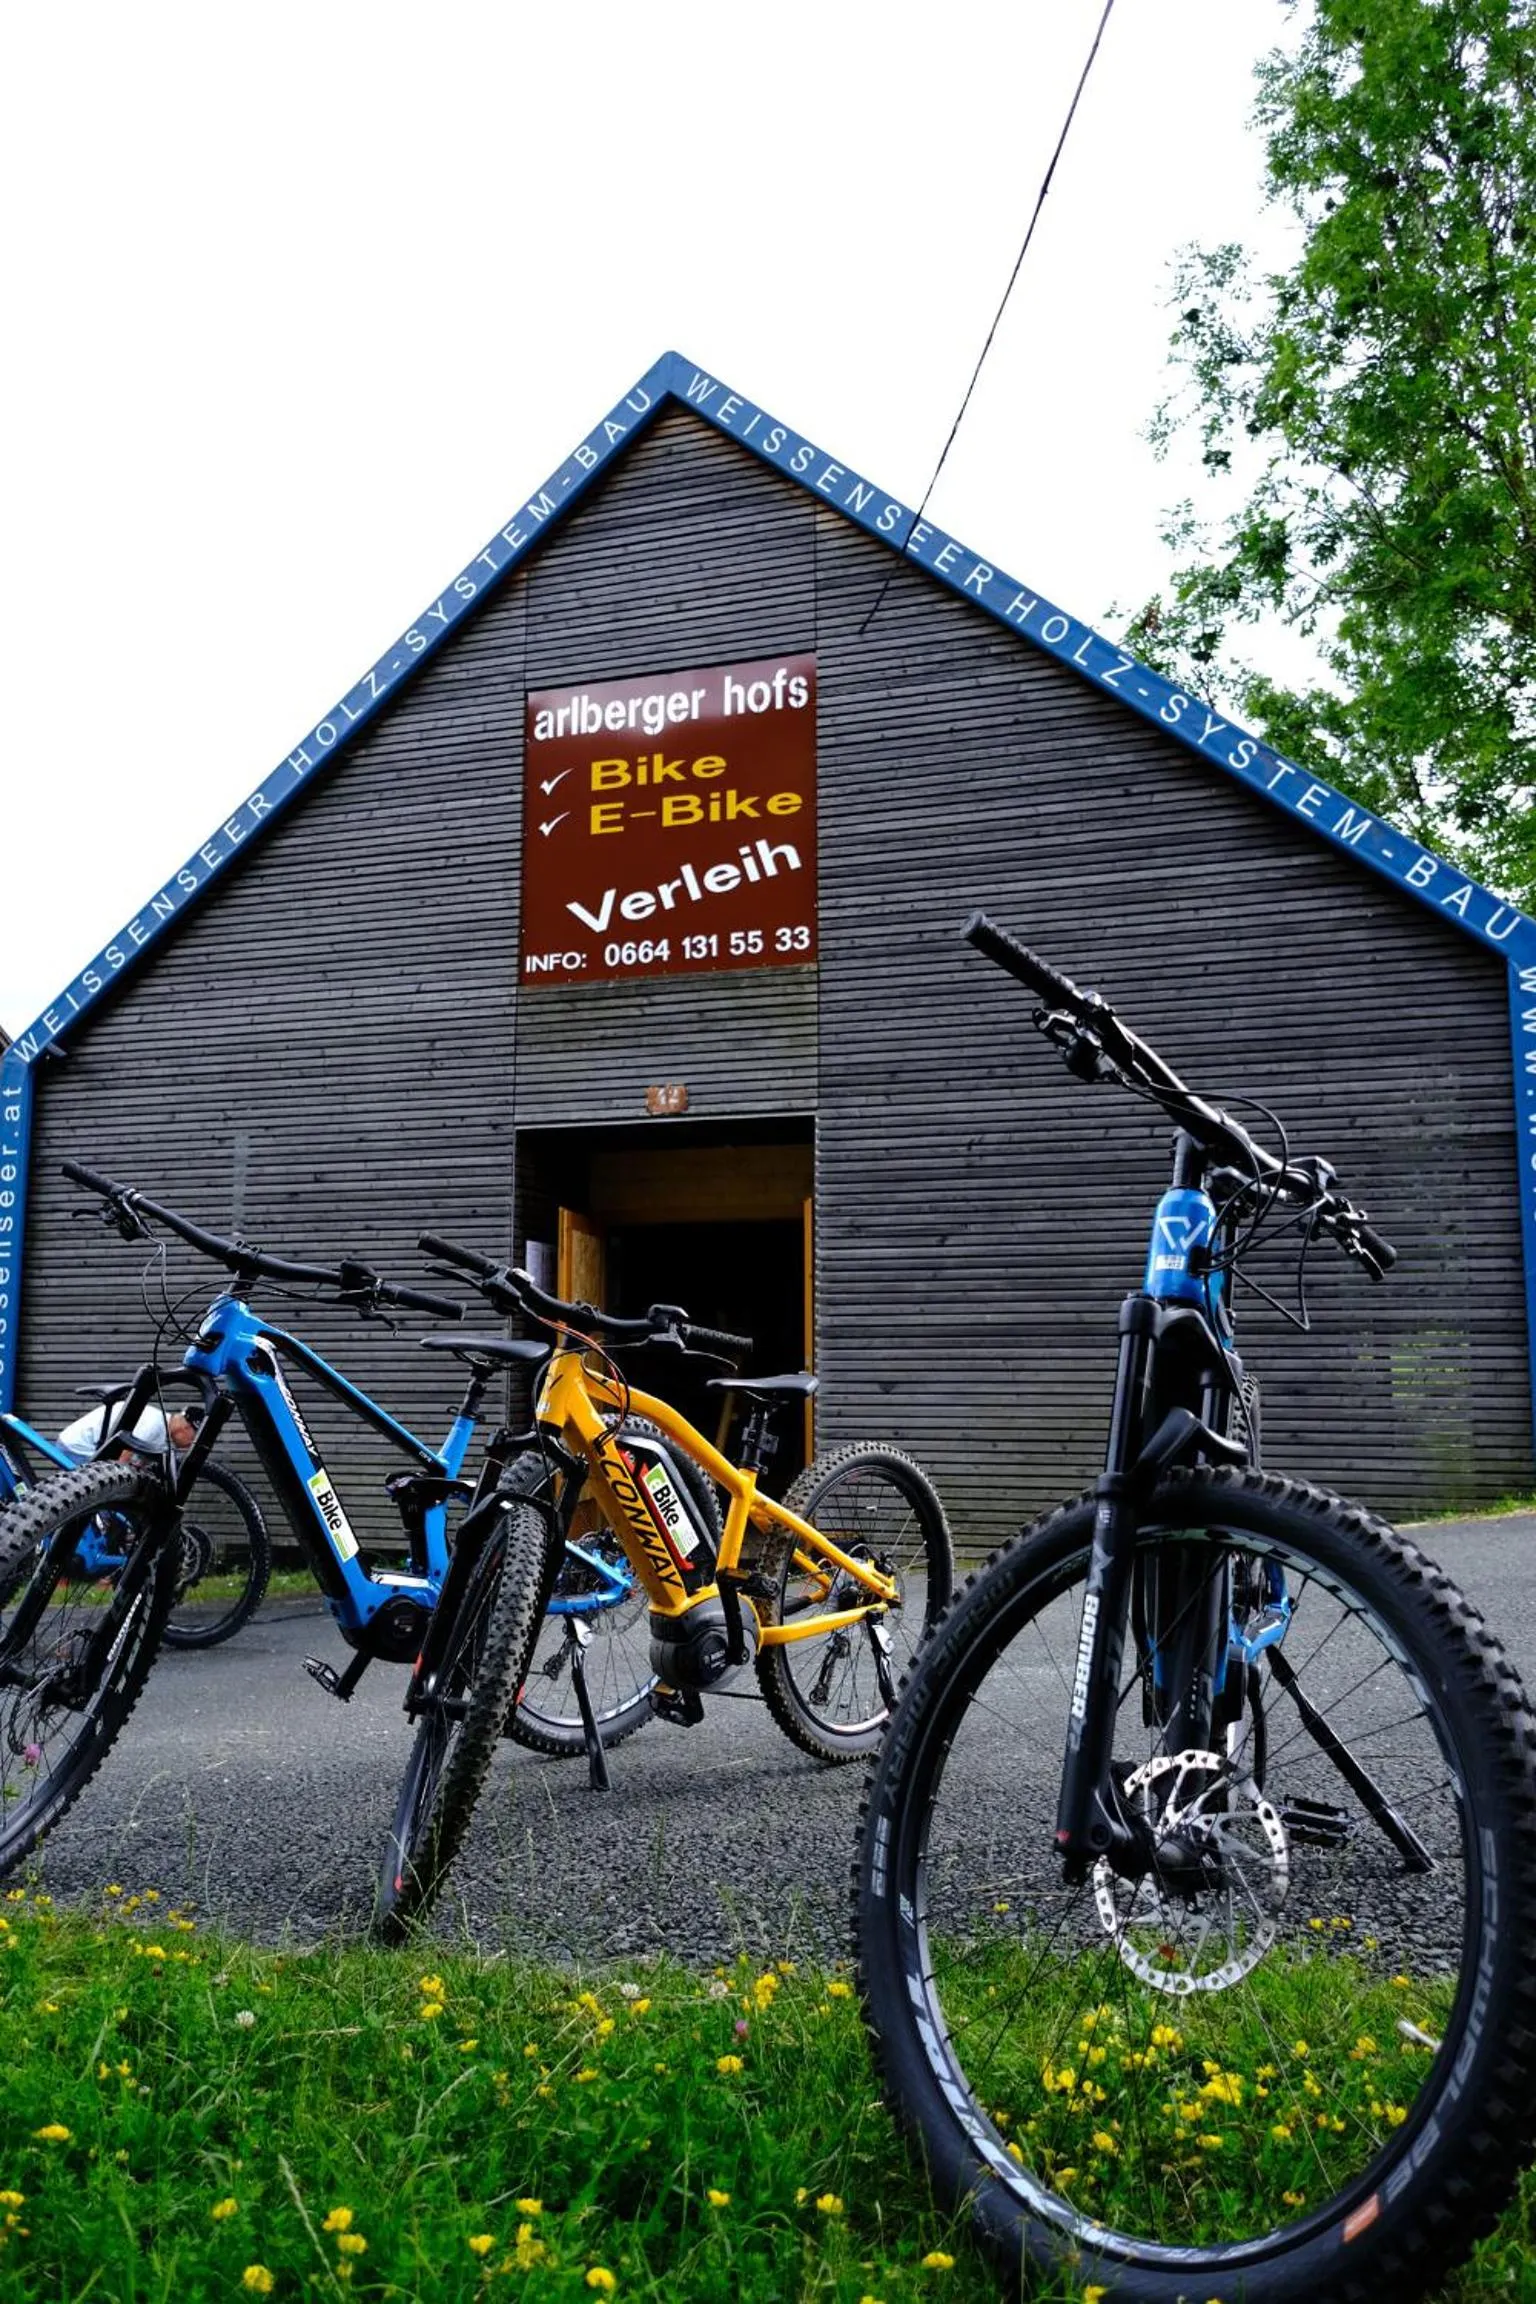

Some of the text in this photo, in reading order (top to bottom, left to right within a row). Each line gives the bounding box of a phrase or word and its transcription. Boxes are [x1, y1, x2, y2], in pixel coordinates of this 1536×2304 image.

[686, 373, 993, 595] WEISSENSEER
[533, 667, 809, 742] arlberger hofs
[590, 753, 728, 792] Bike
[590, 789, 803, 836] E-Bike
[14, 792, 274, 1063] WEISSENSEER
[565, 839, 802, 934] Verleih
[525, 925, 811, 973] INFO: 0664 131 55 33
[600, 1459, 684, 1589] CONWAY
[1070, 1593, 1100, 1719] BOMBER
[1380, 1826, 1498, 2205] SCHWALBE
